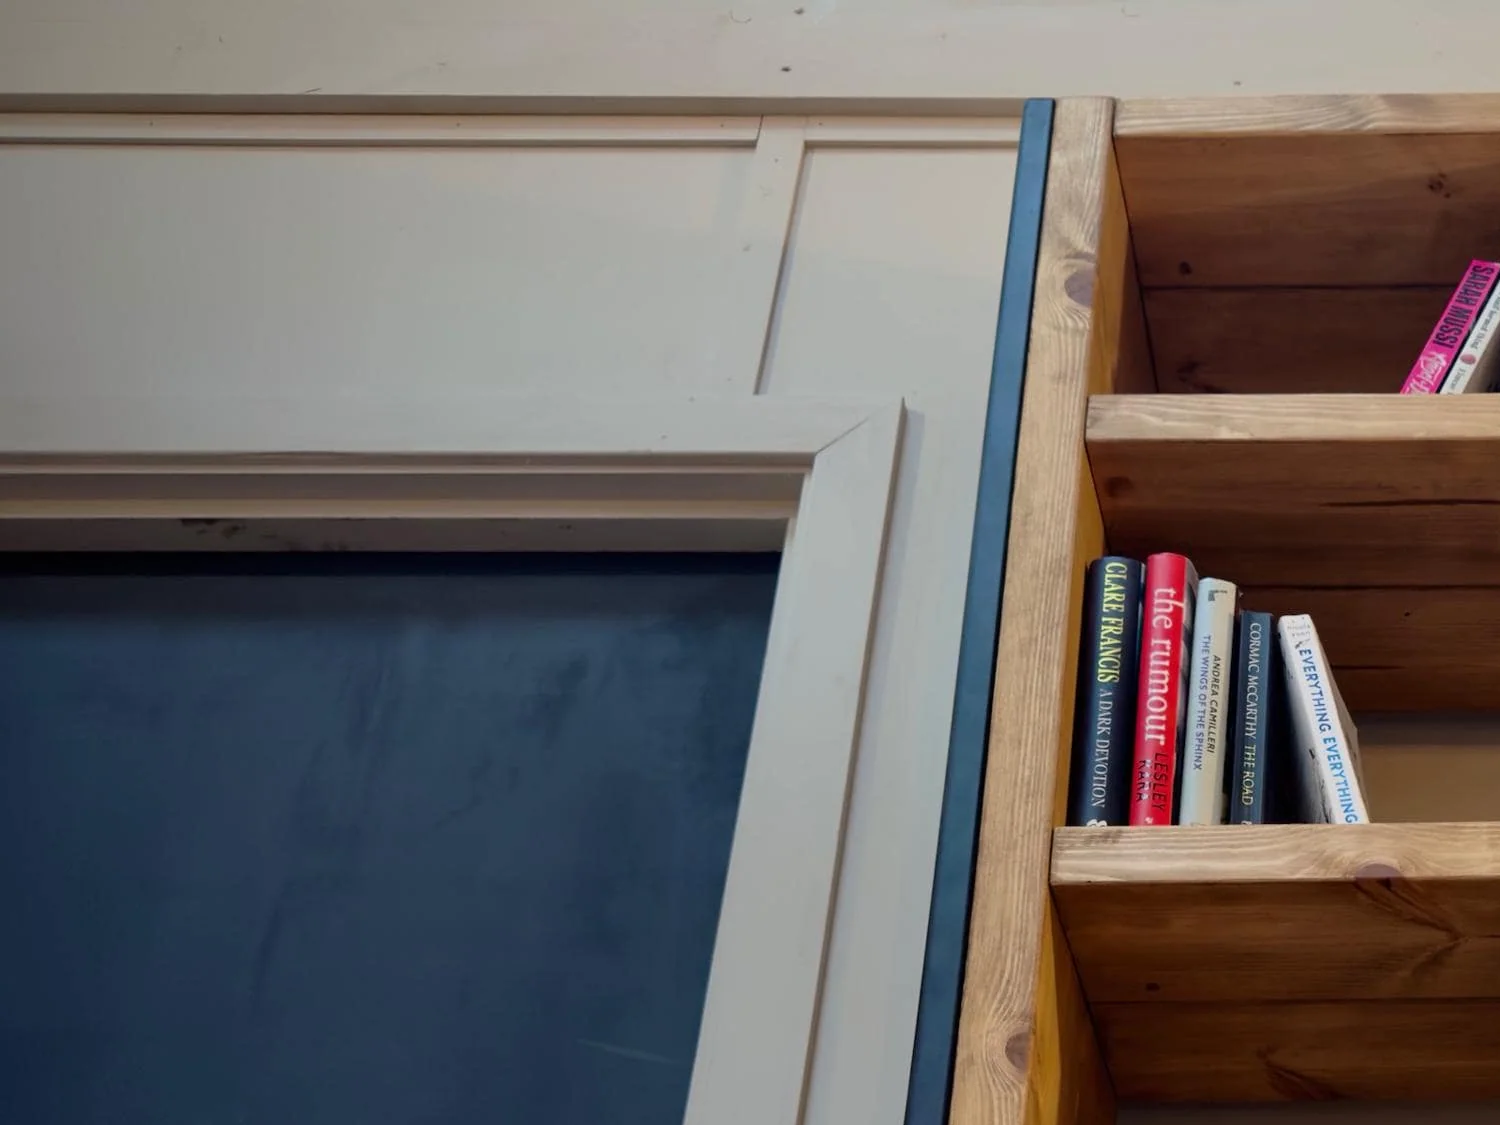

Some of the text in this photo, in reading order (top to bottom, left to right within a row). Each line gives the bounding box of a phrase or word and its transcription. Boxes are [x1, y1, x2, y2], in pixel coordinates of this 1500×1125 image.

[1432, 264, 1494, 349] SARAH MUSSI
[1097, 562, 1127, 683] CLARE FRANCIS
[1144, 587, 1185, 746] the rumour
[1248, 622, 1262, 672] CORMAC
[1091, 688, 1113, 808] A DARK DEVOTION
[1193, 634, 1211, 770] THE WINGS OF THE SPHINX
[1206, 654, 1222, 754] ANDREA CAMILLERI
[1299, 648, 1332, 732] EVERYTHING
[1322, 737, 1358, 824] EVERYTHING
[1136, 759, 1153, 802] KARA
[1151, 752, 1168, 812] LESLEY
[1241, 744, 1257, 806] THE ROAD
